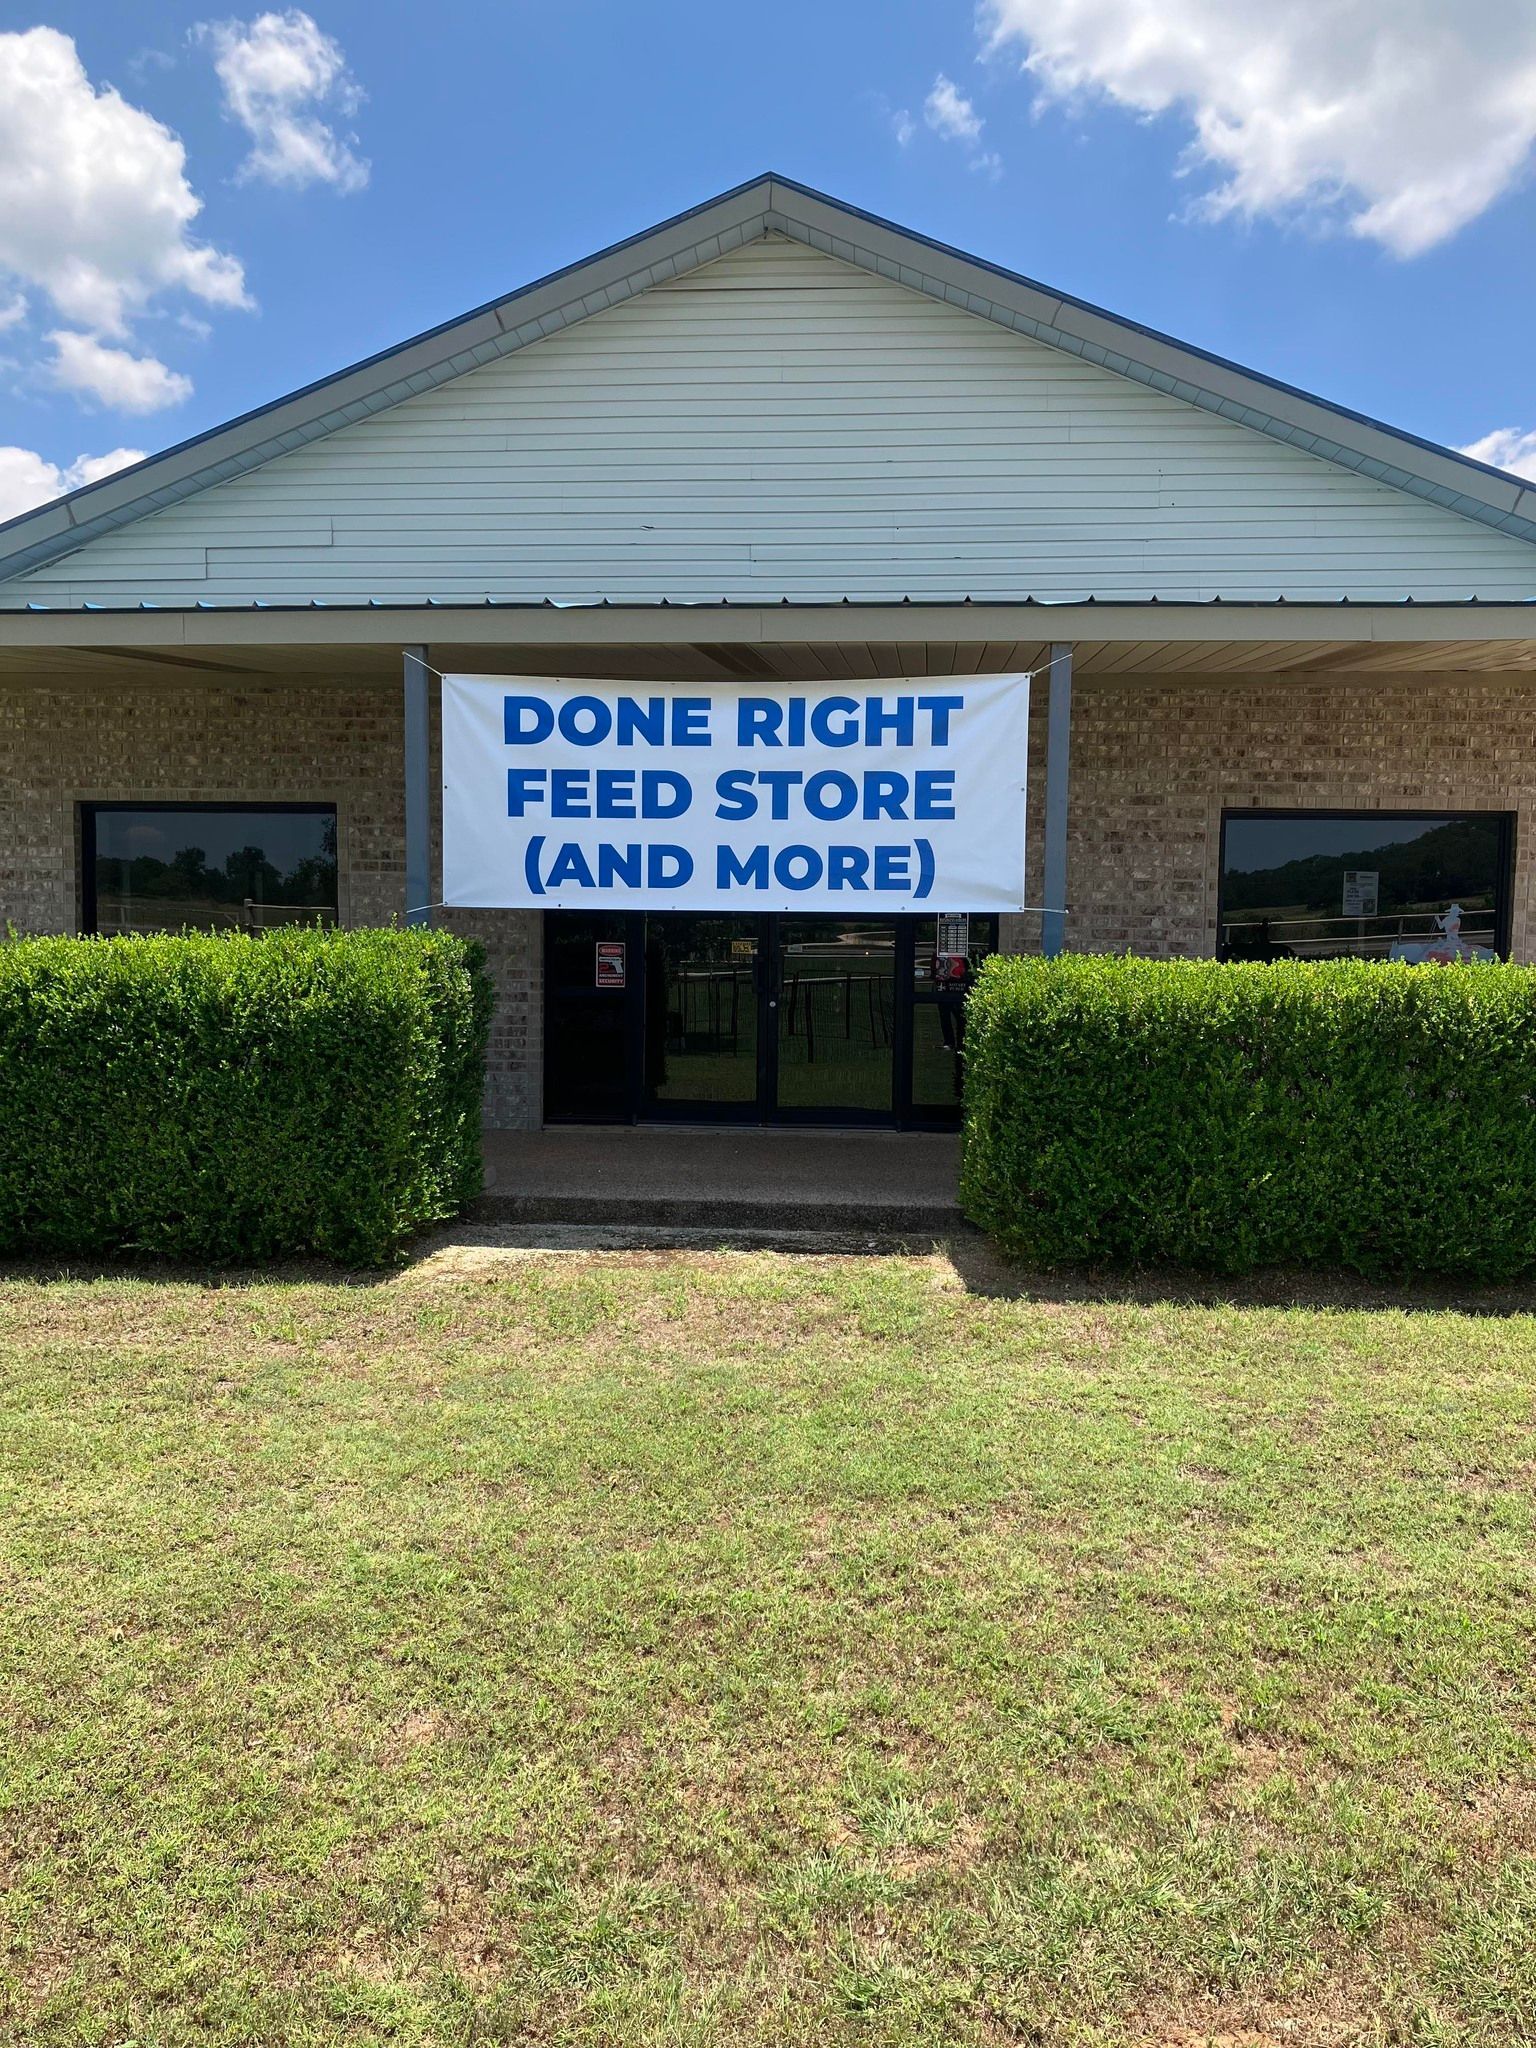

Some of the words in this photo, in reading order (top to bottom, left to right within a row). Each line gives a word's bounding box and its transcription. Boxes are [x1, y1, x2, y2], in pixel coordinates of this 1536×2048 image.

[504, 696, 712, 747] DONE
[738, 696, 964, 748] RIGHT
[508, 769, 693, 820] FEED
[716, 770, 956, 822] STORE
[525, 836, 694, 895] (AND
[717, 839, 936, 899] MORE)
